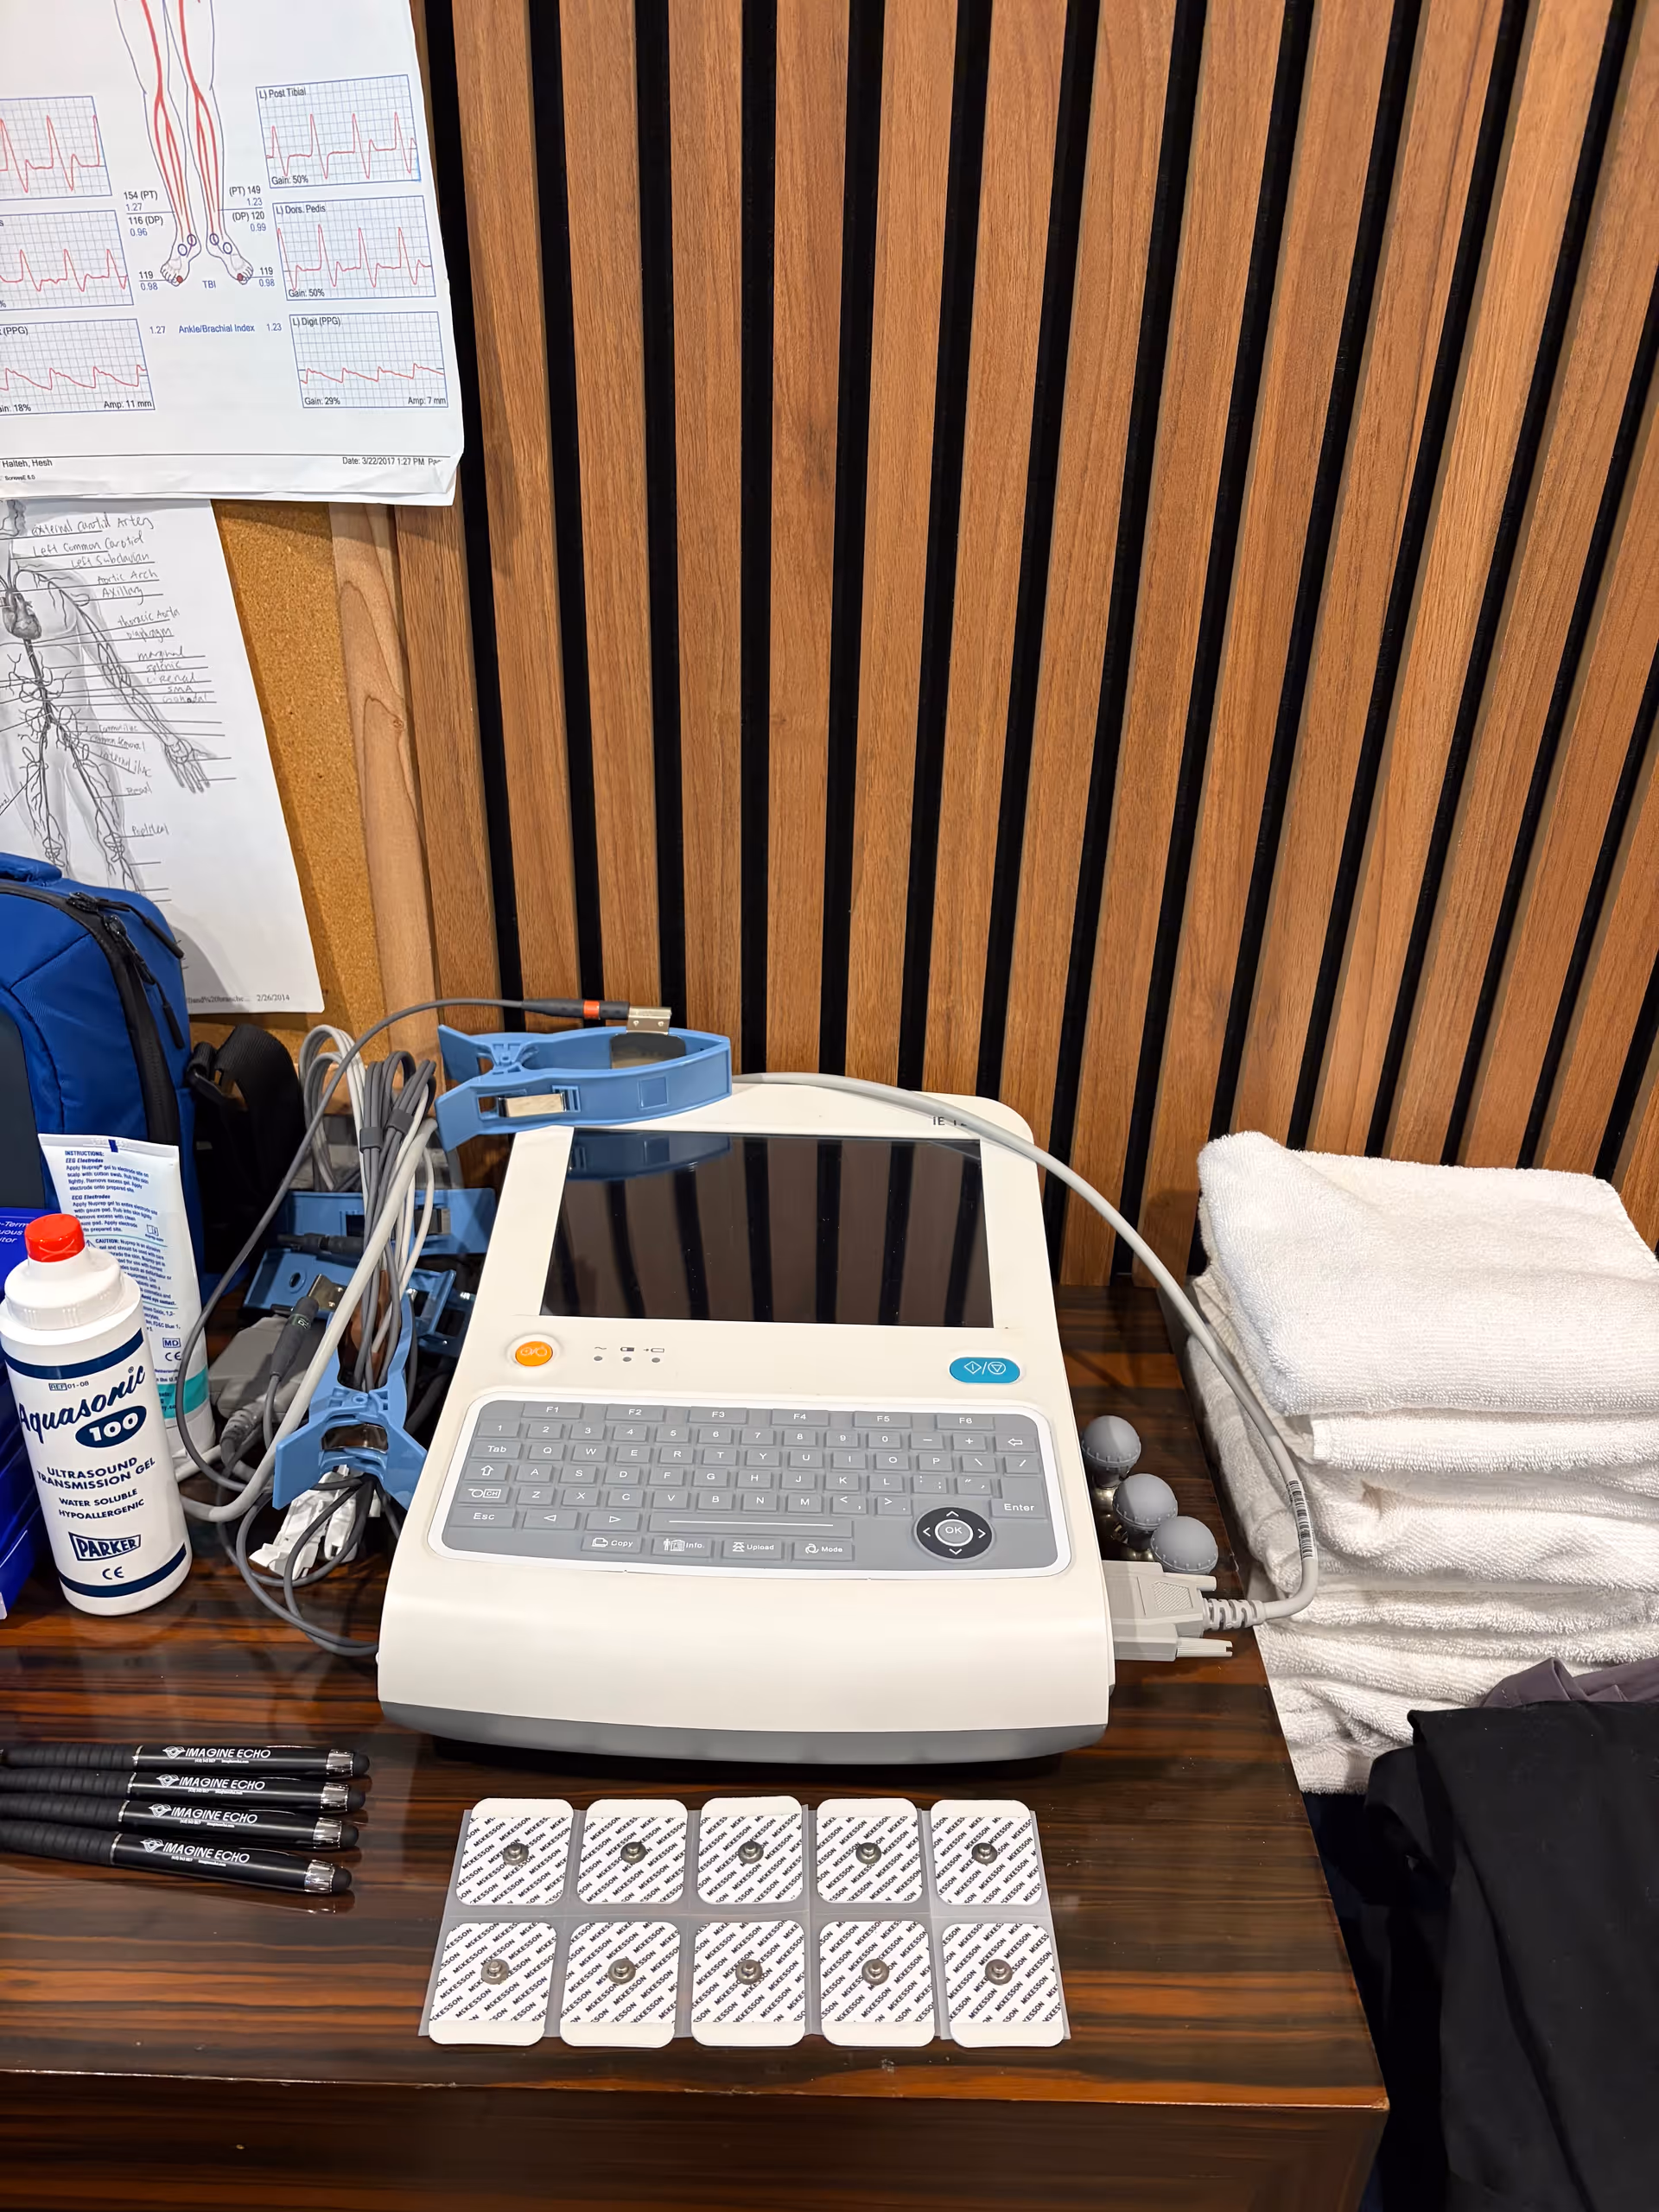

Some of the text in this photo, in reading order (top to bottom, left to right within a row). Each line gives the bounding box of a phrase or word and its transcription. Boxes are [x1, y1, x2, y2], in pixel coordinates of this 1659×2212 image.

[258, 86, 307, 100] L) Post Tibial
[271, 175, 309, 185] Gain: 50%
[124, 190, 158, 200] 154 (PT)
[229, 185, 261, 197] (PT) 149
[125, 202, 143, 212] 1.27
[247, 197, 264, 207] 1.23
[276, 204, 326, 216] L) Dors. Pedis
[128, 215, 163, 226] 116 (DP)
[232, 211, 265, 222] (DP) 120
[130, 227, 148, 236] 0.96
[250, 223, 266, 232] 0.99
[138, 270, 154, 279] 119
[259, 266, 274, 276] 119
[202, 280, 217, 289] TBI
[259, 278, 275, 287] 0.98
[288, 288, 325, 298] Gain: 50%
[292, 316, 341, 327] L) Digit (PPG)
[3, 326, 29, 337] (PPG)
[149, 325, 166, 334] 1.27
[178, 323, 256, 334] Ankle/Brachial Index
[266, 322, 283, 332] 1.23
[104, 399, 153, 410] Amp: 11 mm
[304, 397, 341, 406] Gain: 29%
[407, 397, 427, 407] Amp:
[13, 404, 32, 412] 18%
[31, 458, 53, 467] Hesh
[342, 456, 360, 465] Date:
[361, 456, 395, 466] 3/22/2017
[397, 457, 411, 466] 1:27
[413, 457, 425, 466] PM
[33, 530, 143, 557] Left Common Carotid
[71, 553, 149, 568] Left Subclavian
[130, 569, 158, 580] Arch
[256, 993, 290, 1002] 2/26/2014
[19, 1365, 146, 1444] Aquasonic
[89, 1412, 138, 1442] 100
[486, 1444, 507, 1452] Tab
[47, 1457, 138, 1479] ULTRASOUND
[37, 1458, 156, 1491] TRANSMISSION GEL
[59, 1488, 138, 1507] WATER SOLUBLE
[59, 1498, 144, 1520] HYPOALLERGENIC
[1003, 1503, 1035, 1511] Enter
[473, 1512, 495, 1521] Esc
[944, 1526, 963, 1535] OK
[77, 1535, 138, 1558] PARKER
[610, 1539, 633, 1548] Copy
[746, 1543, 774, 1552] Upload
[820, 1545, 843, 1554] Mode
[185, 1748, 271, 1758] IMAGINE ECHO
[179, 1777, 265, 1790] IMAGINE ECHO
[171, 1807, 222, 1821] IMAGINE
[223, 1811, 257, 1824] ECHO
[162, 1842, 214, 1859] IMAGINE
[214, 1849, 251, 1864] ECHO
